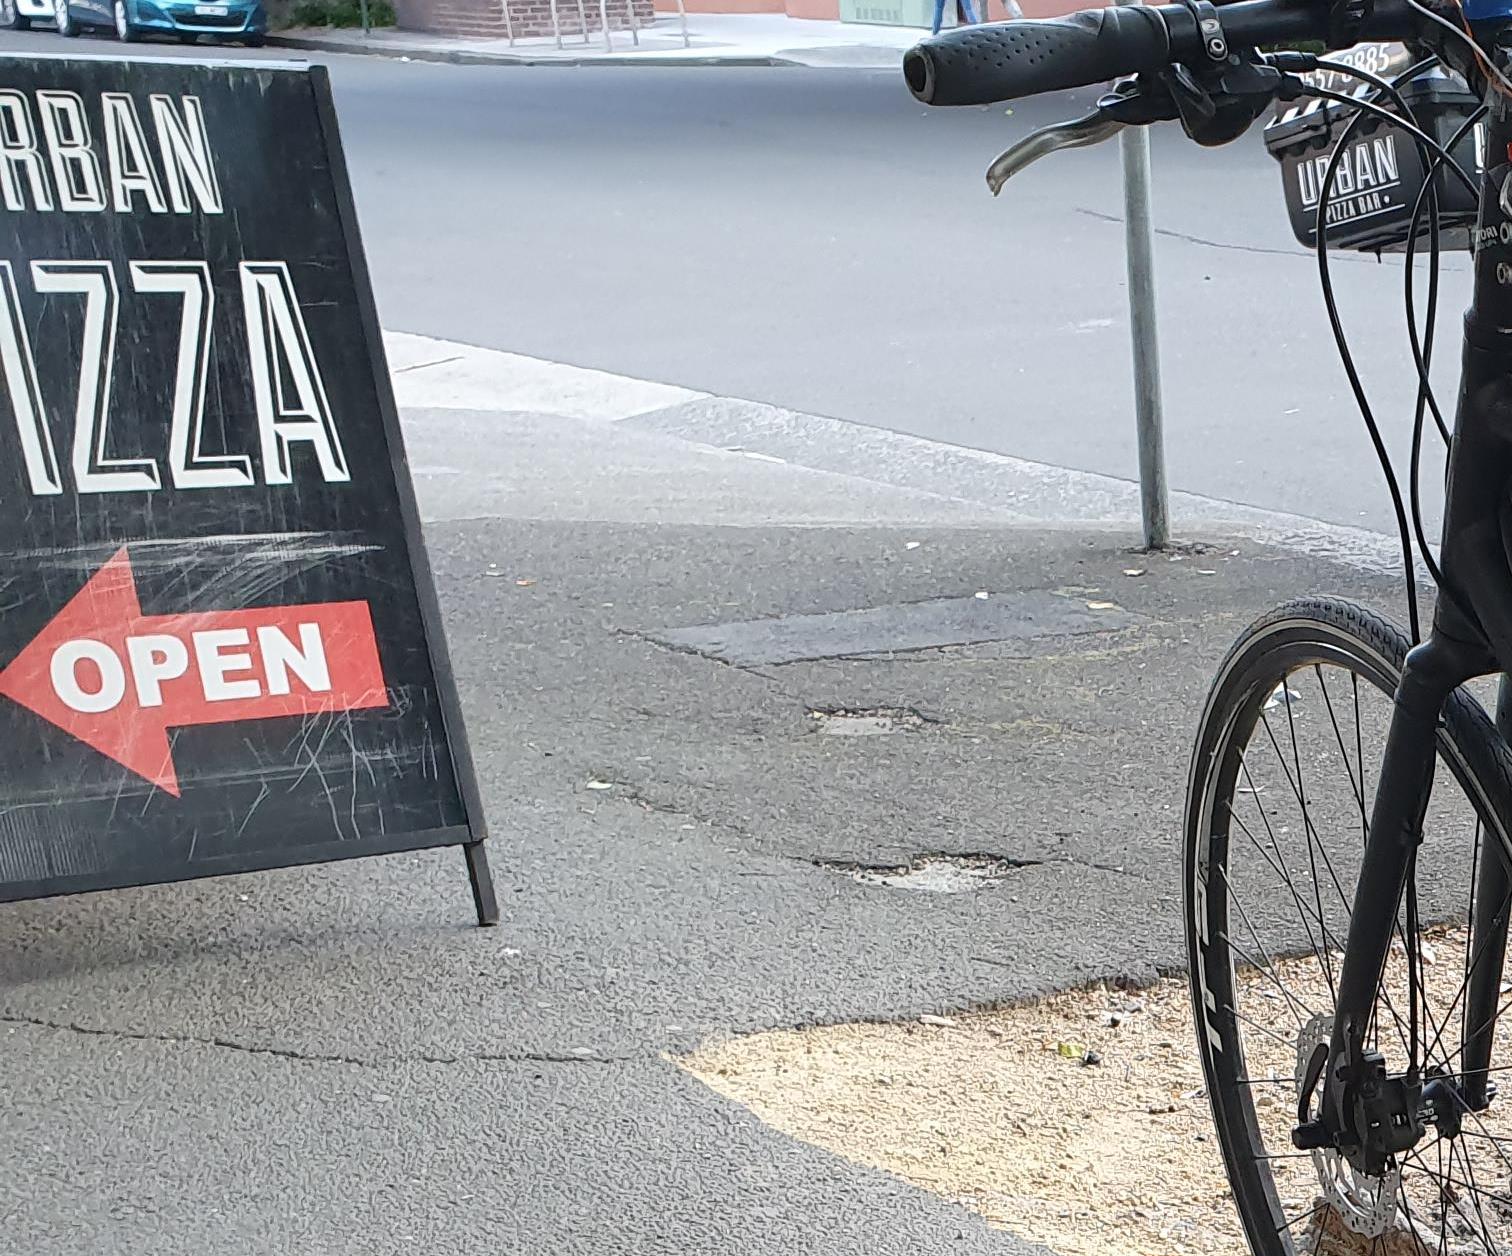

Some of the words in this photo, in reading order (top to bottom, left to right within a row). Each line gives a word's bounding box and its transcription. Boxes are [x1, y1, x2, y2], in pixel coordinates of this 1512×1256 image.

[1326, 200, 1357, 223] PIZZA
[1358, 192, 1382, 214] BAR
[49, 622, 332, 713] OPEN
